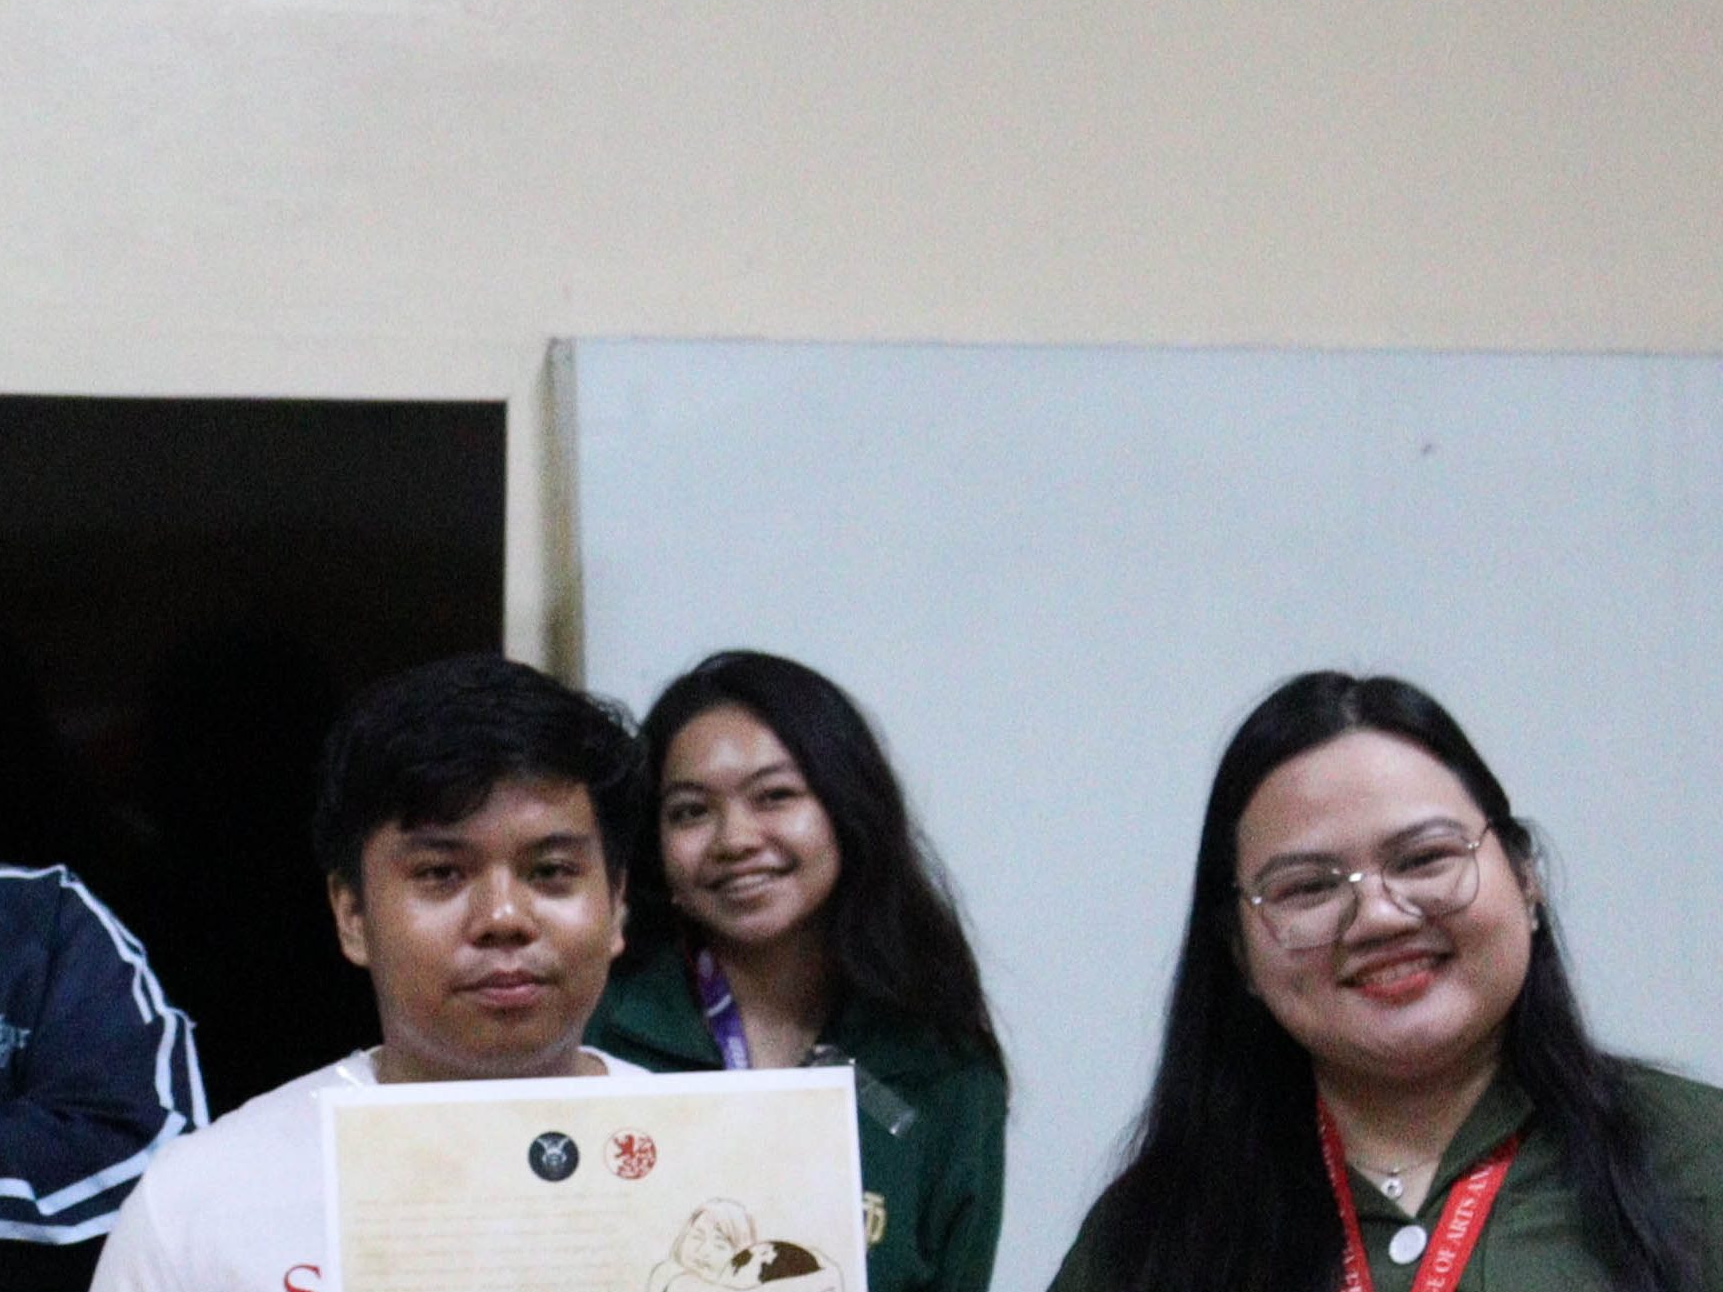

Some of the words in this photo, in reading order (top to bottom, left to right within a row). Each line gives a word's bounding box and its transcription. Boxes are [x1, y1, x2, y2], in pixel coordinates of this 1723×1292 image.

[1435, 1248, 1456, 1277] OF
[1447, 1195, 1477, 1248] ARTS
[1467, 1164, 1495, 1195] AN
